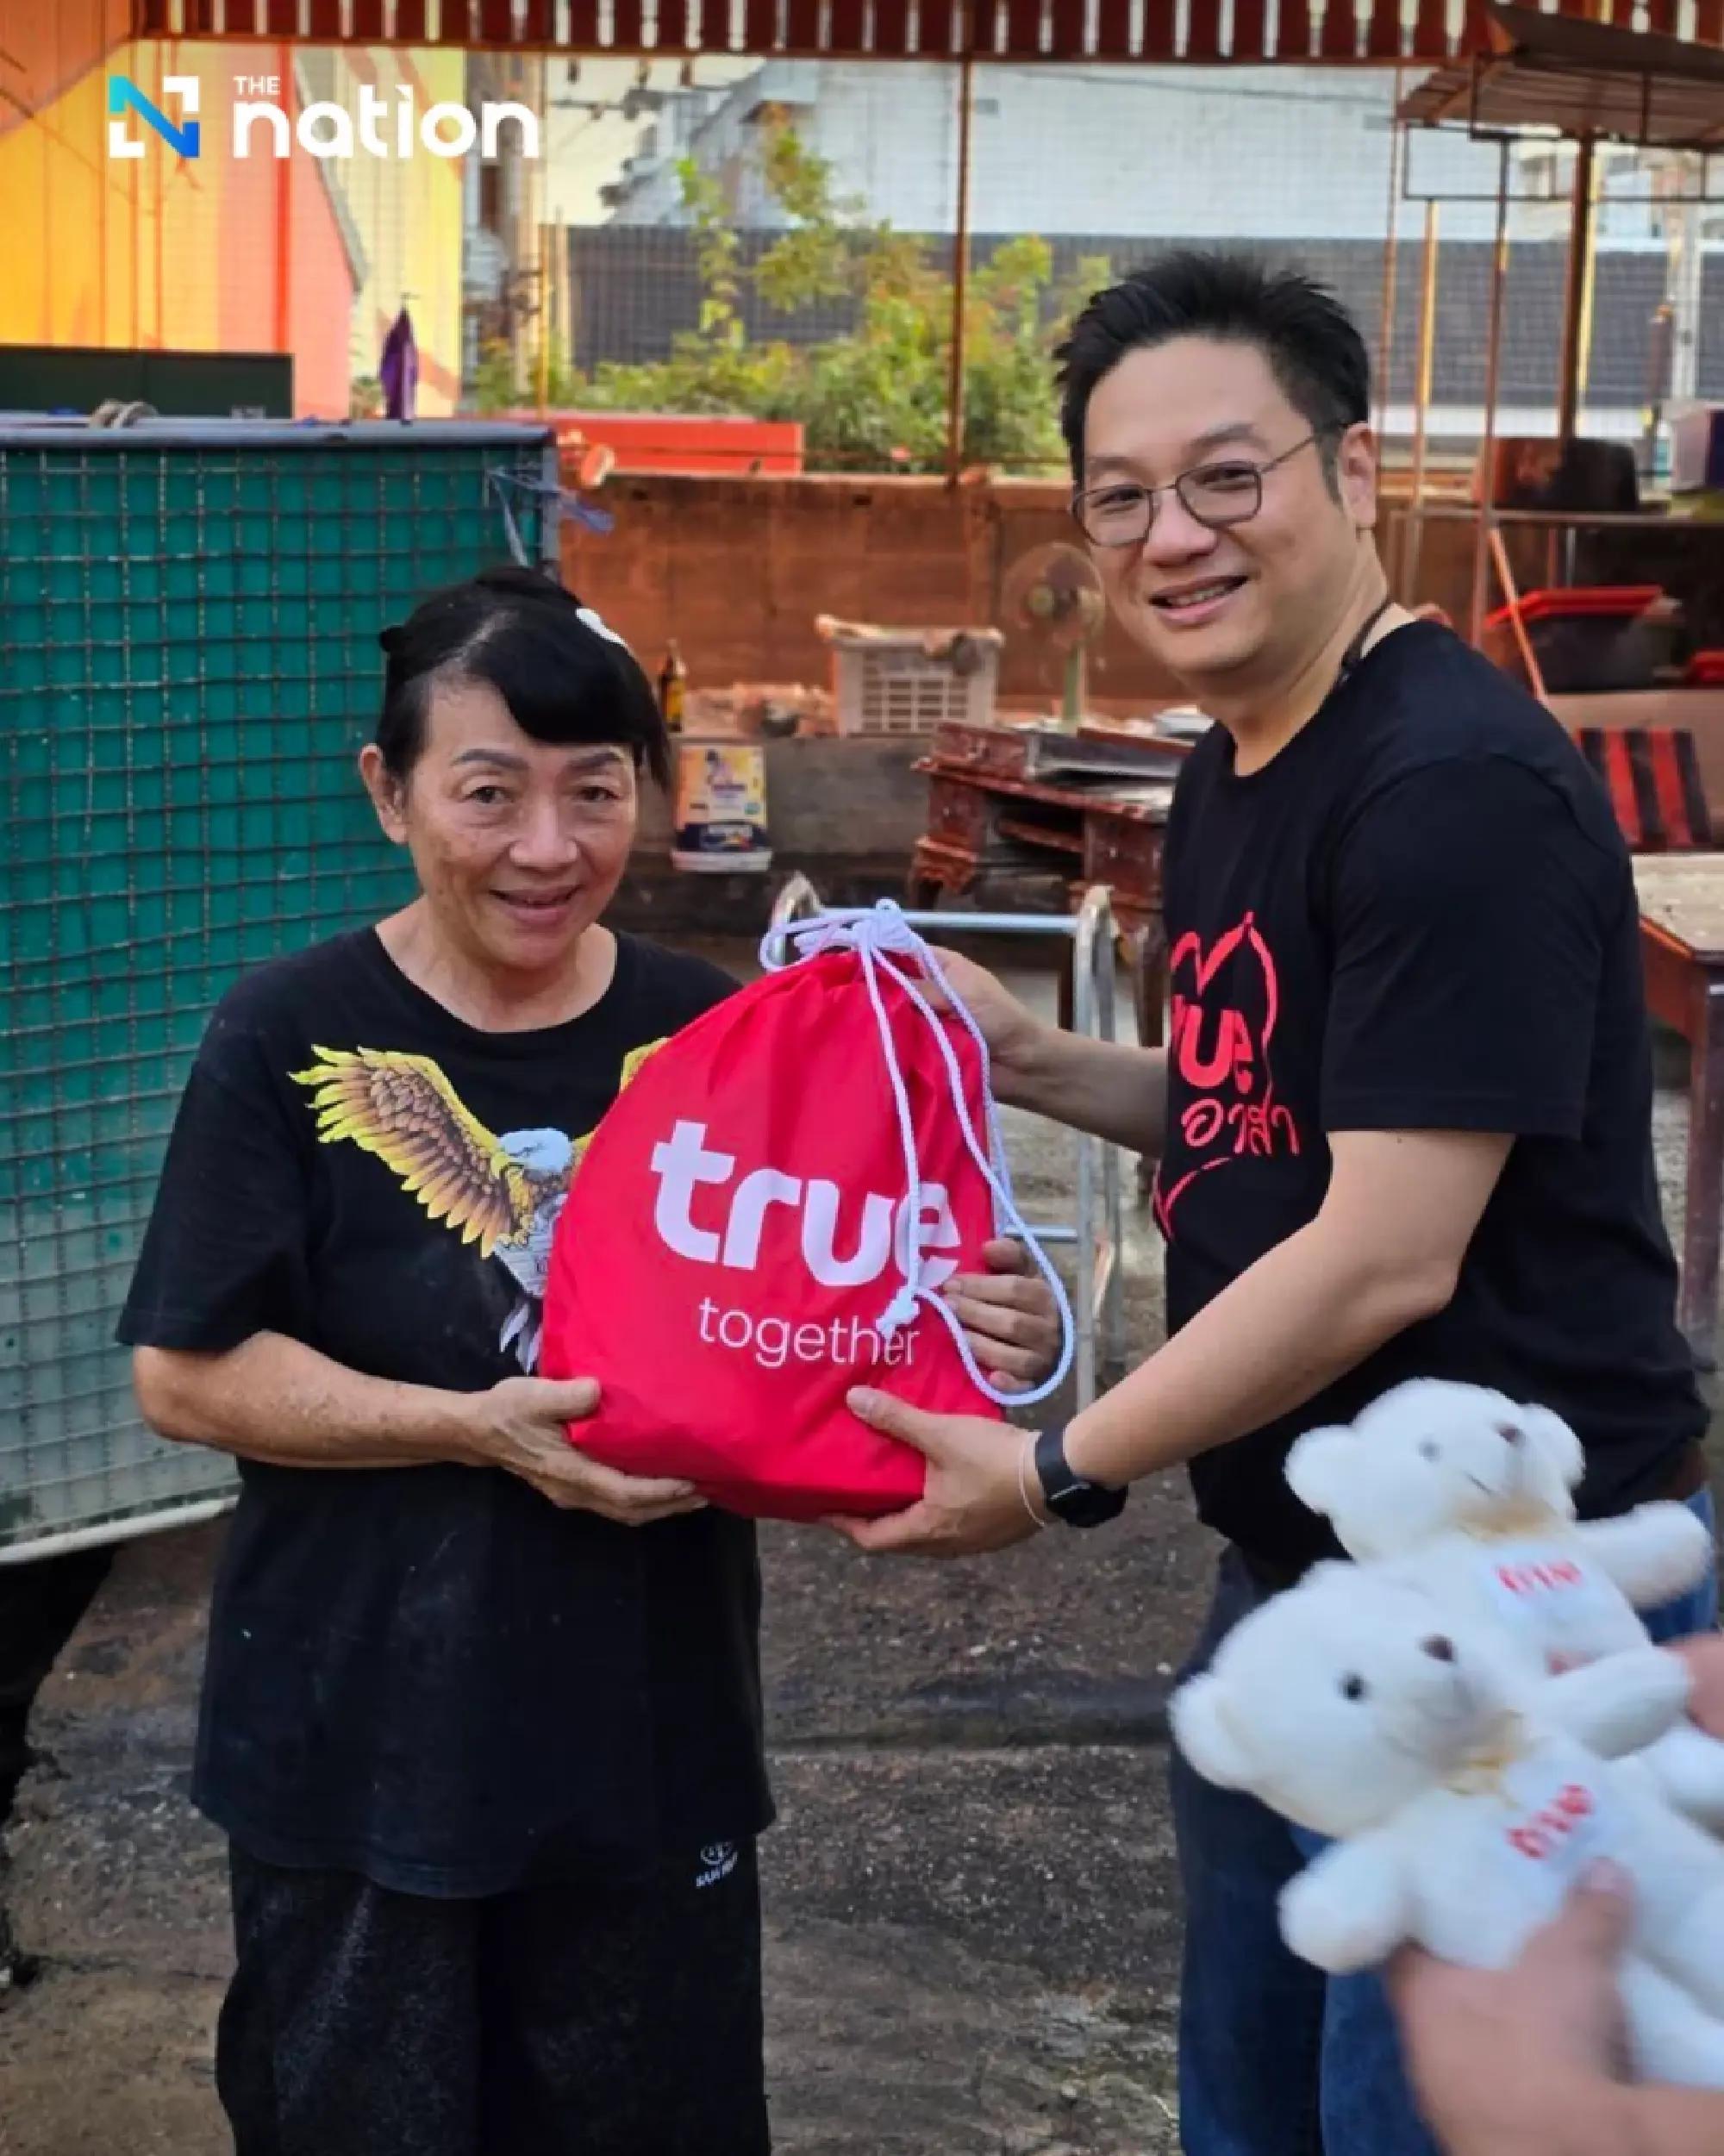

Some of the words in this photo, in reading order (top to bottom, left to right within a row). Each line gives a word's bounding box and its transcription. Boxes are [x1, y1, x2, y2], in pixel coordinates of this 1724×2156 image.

[1171, 994, 1253, 1094] ue
[650, 1119, 962, 1290] true
[699, 1296, 921, 1369] together
